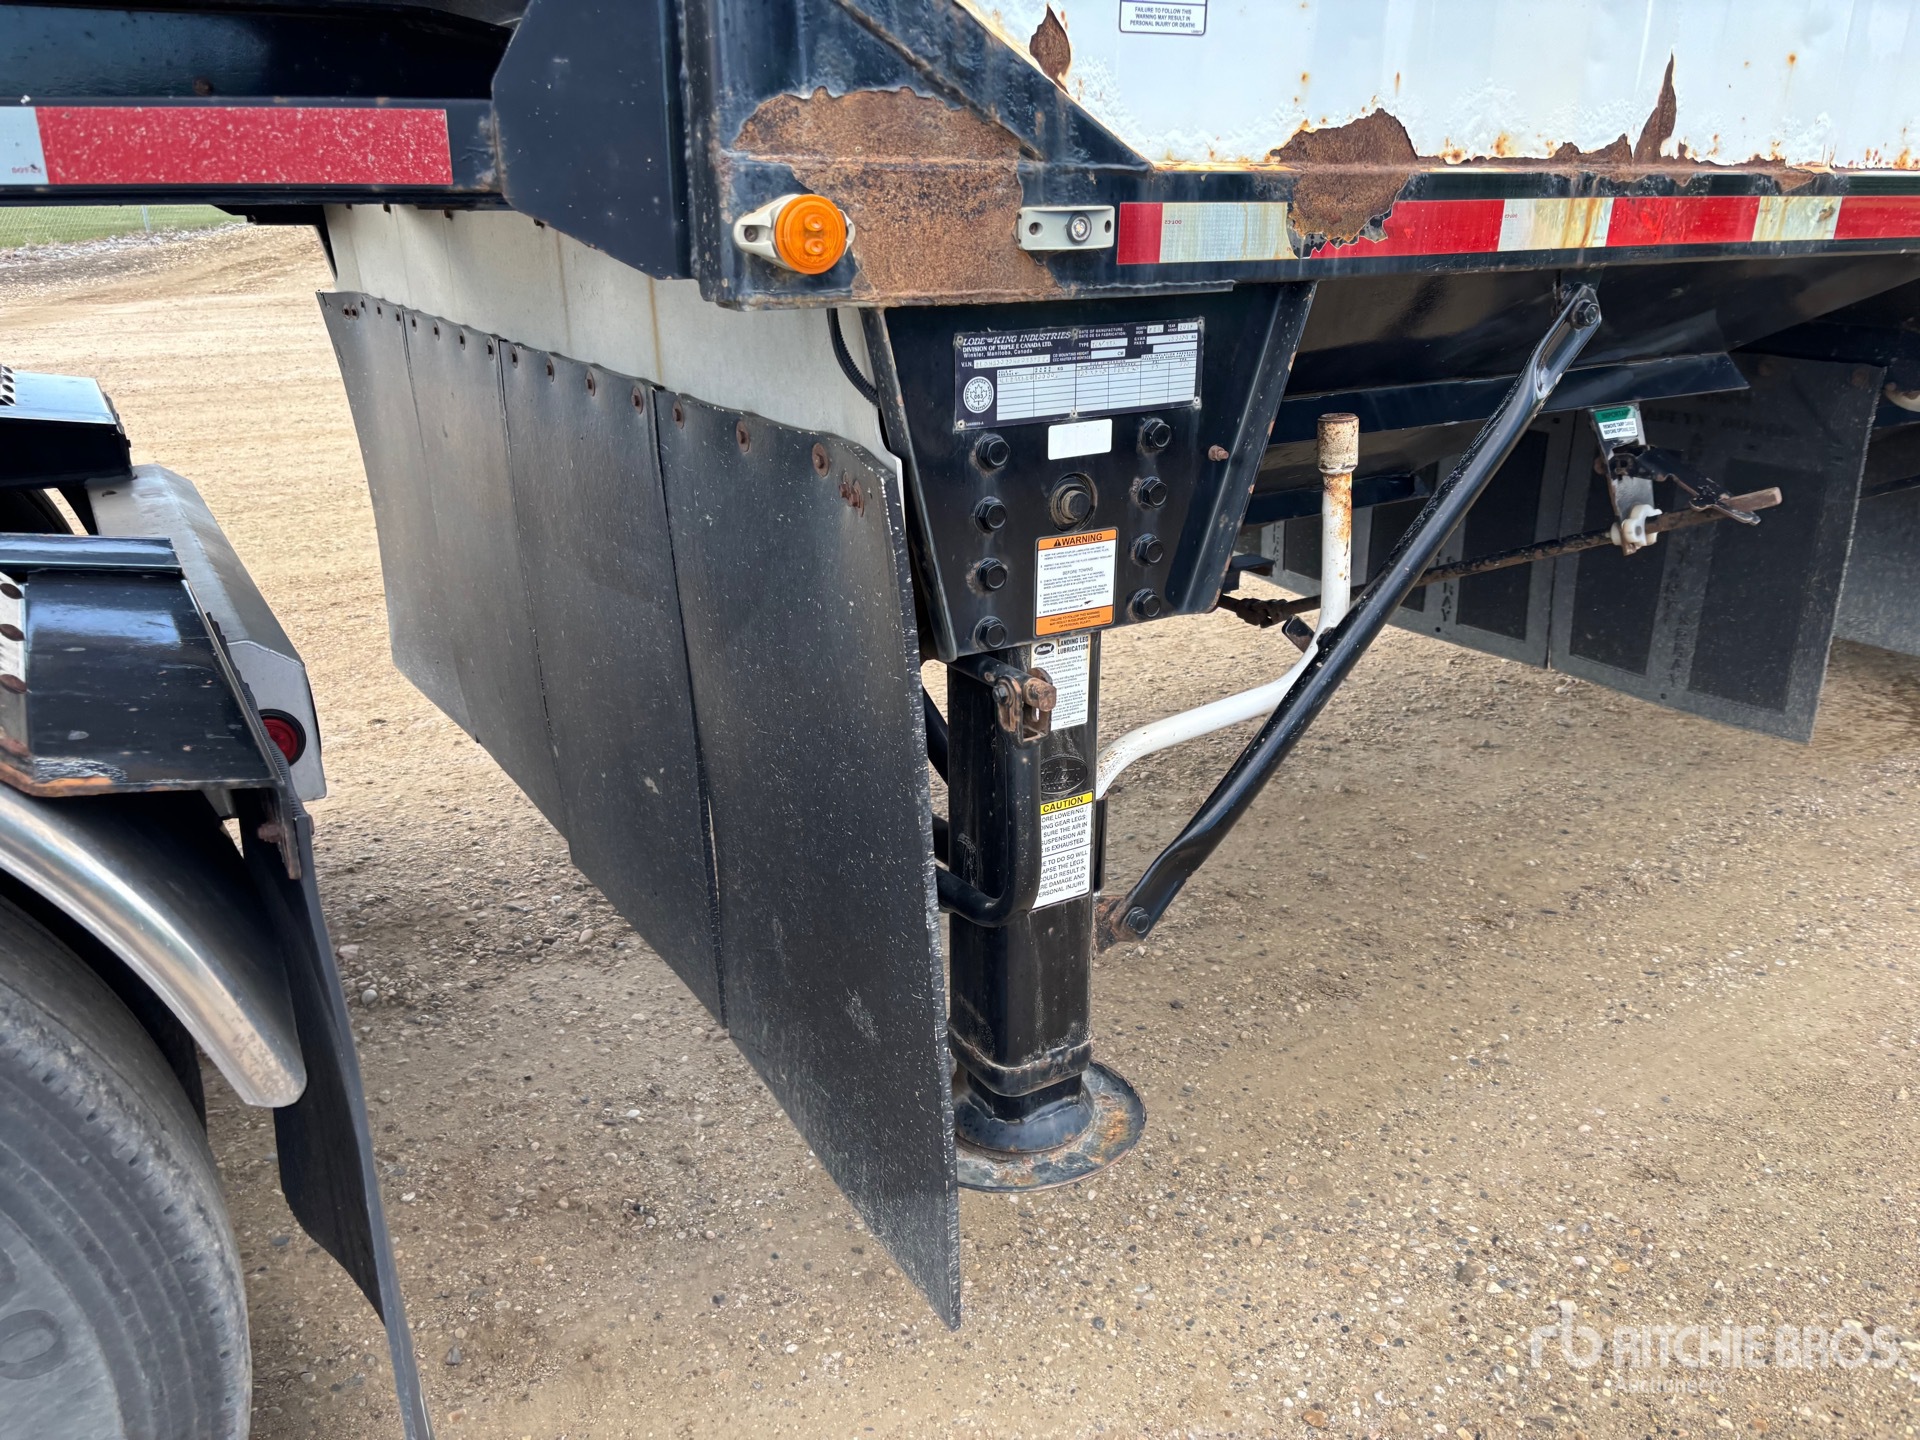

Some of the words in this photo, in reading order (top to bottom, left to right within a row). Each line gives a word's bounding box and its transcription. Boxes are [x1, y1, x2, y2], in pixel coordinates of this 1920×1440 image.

[1020, 331, 1072, 342] INDUSTRIES
[1062, 533, 1102, 546] WARNING
[1057, 637, 1078, 647] LANDING
[1080, 636, 1088, 644] LEG
[1057, 644, 1088, 655] LUBRICATION
[1043, 796, 1083, 812] CAUTION
[1055, 808, 1084, 820] LOWERING
[1054, 819, 1070, 827] GEAR
[1044, 829, 1058, 837] SURE
[1070, 858, 1084, 866] LEGS
[1059, 867, 1079, 877] RESULT
[1049, 877, 1072, 888] DAMAGE
